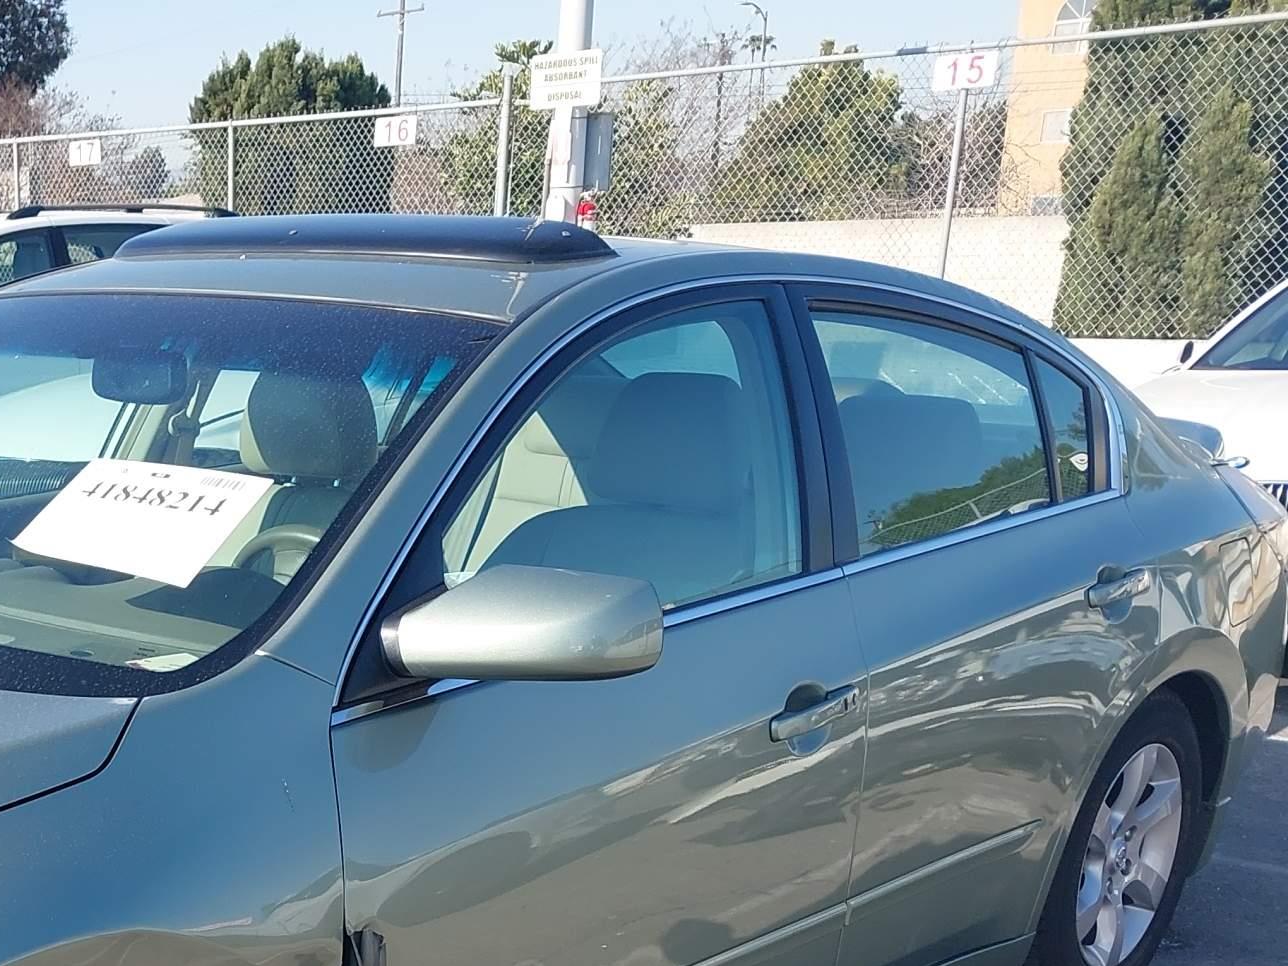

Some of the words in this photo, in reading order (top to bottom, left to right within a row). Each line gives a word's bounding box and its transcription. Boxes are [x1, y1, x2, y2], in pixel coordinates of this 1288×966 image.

[534, 58, 578, 70] HAZARDOUS
[579, 55, 598, 66] SPILL
[947, 56, 985, 86] 15
[547, 90, 582, 101] DISPOSAL
[384, 119, 409, 143] 16
[75, 142, 95, 162] 17
[82, 481, 228, 516] 41848214
